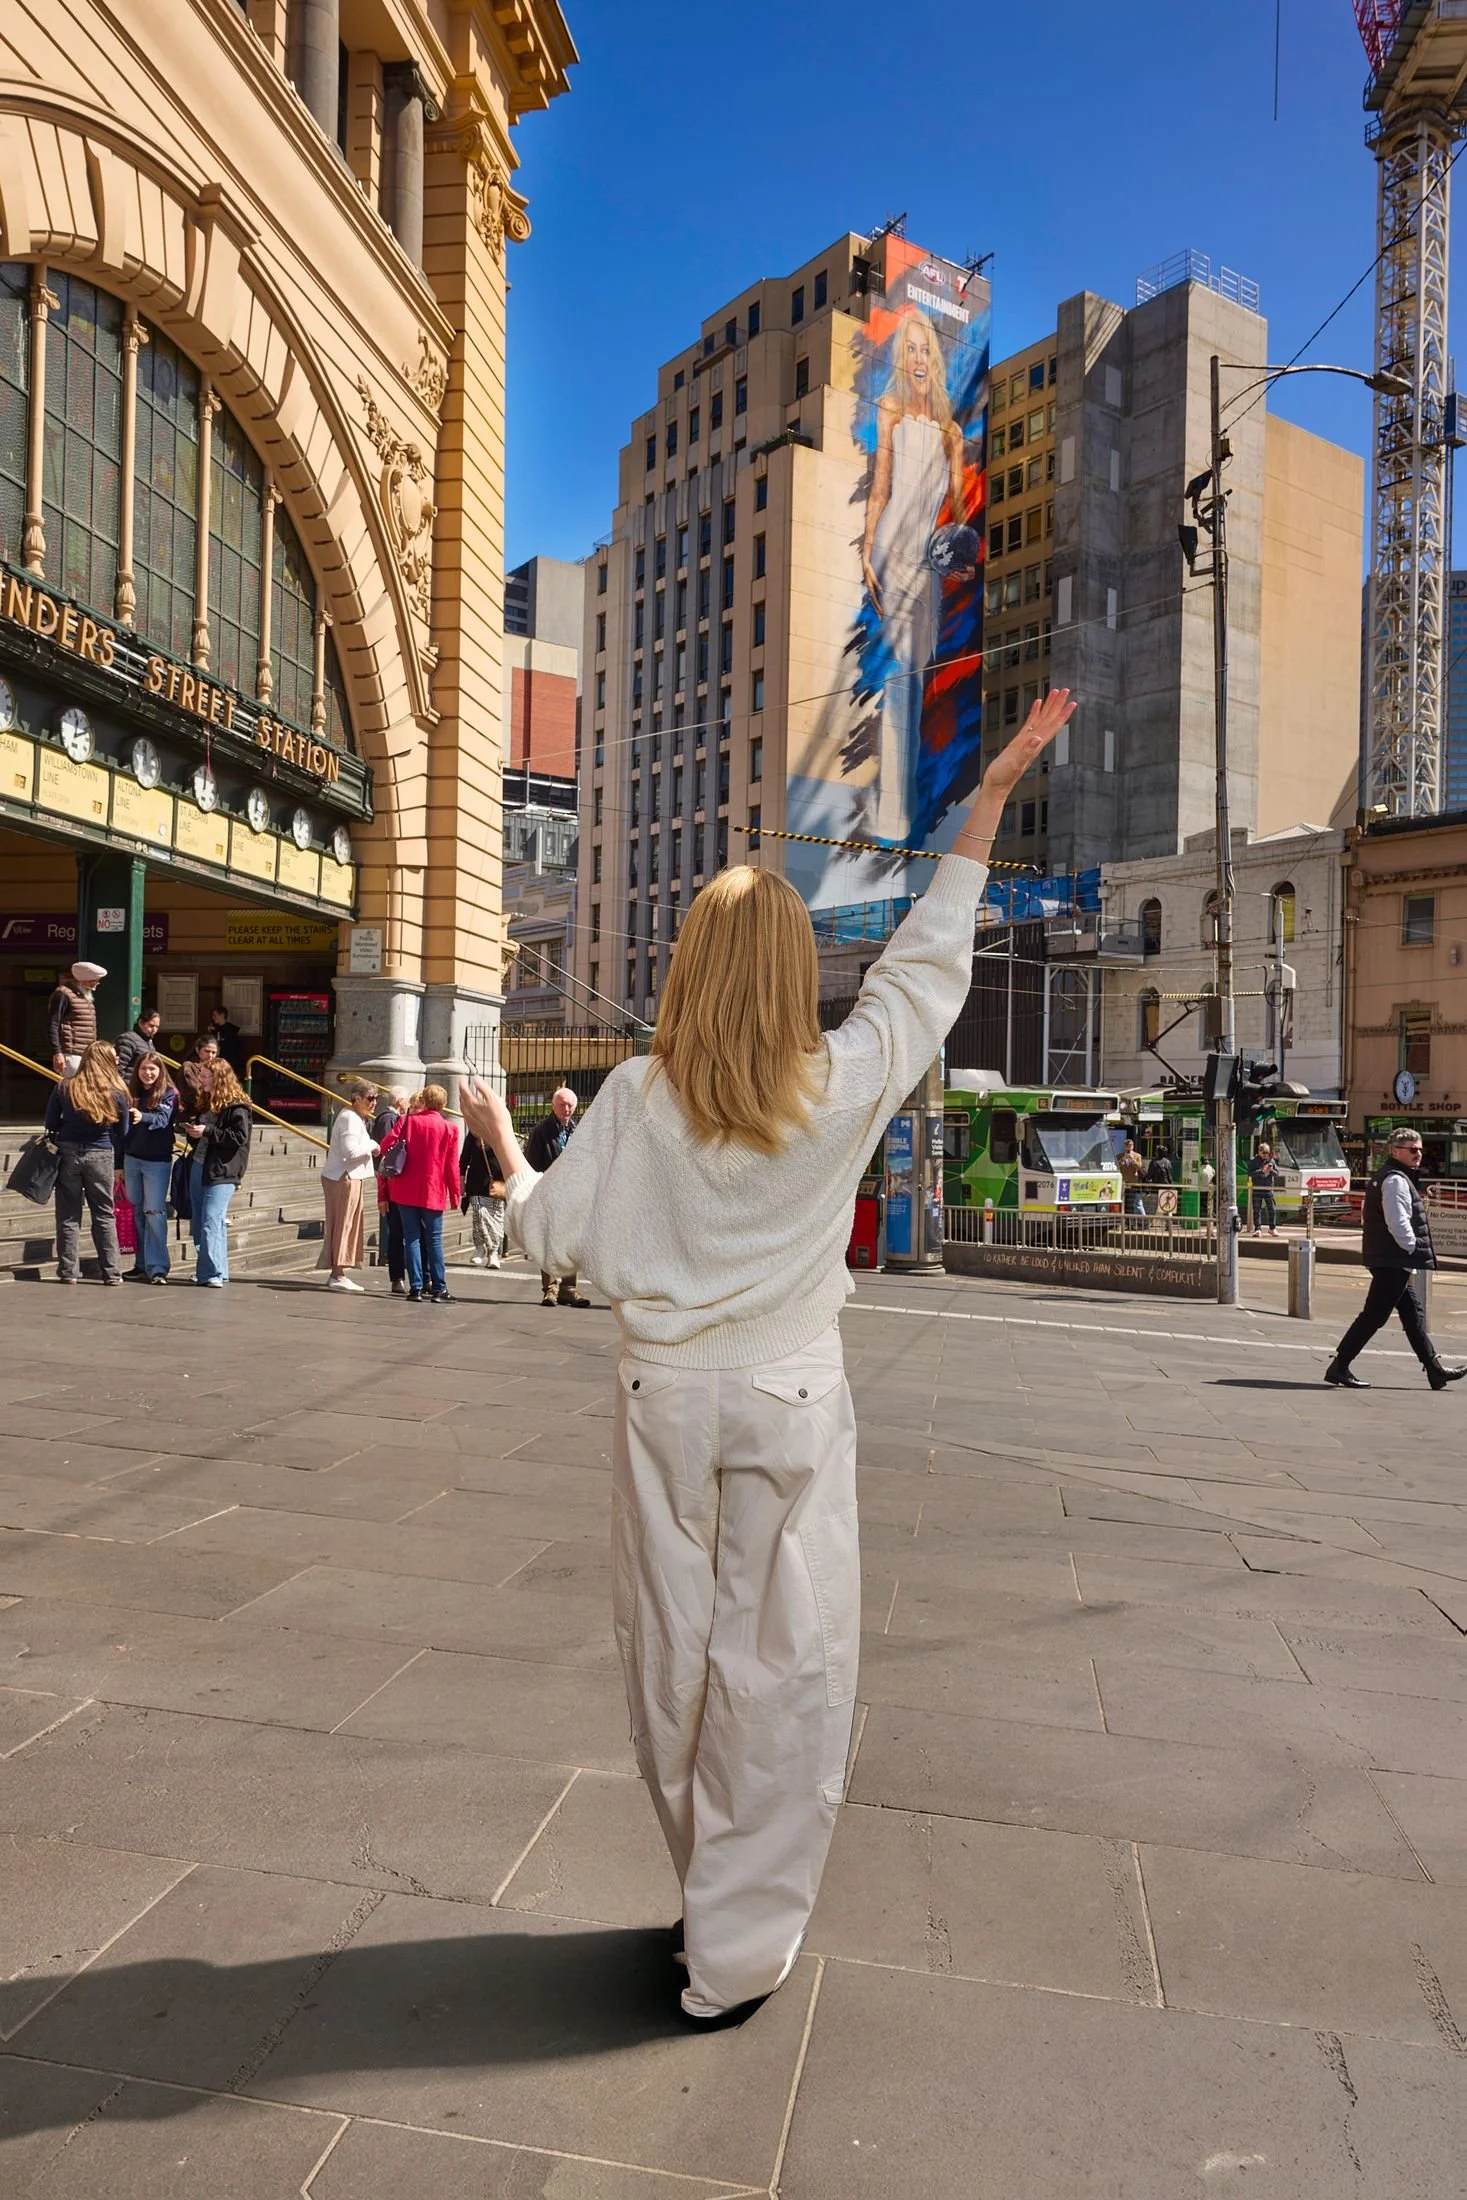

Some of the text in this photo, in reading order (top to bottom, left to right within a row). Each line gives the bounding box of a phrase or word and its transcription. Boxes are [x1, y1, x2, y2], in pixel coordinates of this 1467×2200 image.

[921, 265, 945, 283] AFL
[907, 283, 970, 324] ENTERTAINMENT
[143, 656, 238, 729] STREET
[256, 716, 340, 783] STATION
[43, 752, 98, 783] WILLIAMSTOWN
[43, 770, 60, 786] LINE
[116, 779, 142, 798] ALTONA
[116, 795, 131, 810] LINE
[98, 919, 111, 929] NO
[227, 925, 333, 935] PLEASE KEEP THE STAIRS
[47, 924, 76, 941] Reg
[227, 935, 312, 945] CLEAR AT ALL TIMES
[1380, 1102, 1461, 1112] BOTTLE SHOP
[1038, 1180, 1054, 1189] 2076
[1287, 1175, 1299, 1183] 243
[992, 1253, 1017, 1266] RATHER
[1020, 1255, 1030, 1266] BE
[1031, 1256, 1049, 1269] LOUD
[1058, 1259, 1090, 1274] UNLIKED
[1093, 1262, 1111, 1276] THAN
[1112, 1263, 1145, 1279] SILENT
